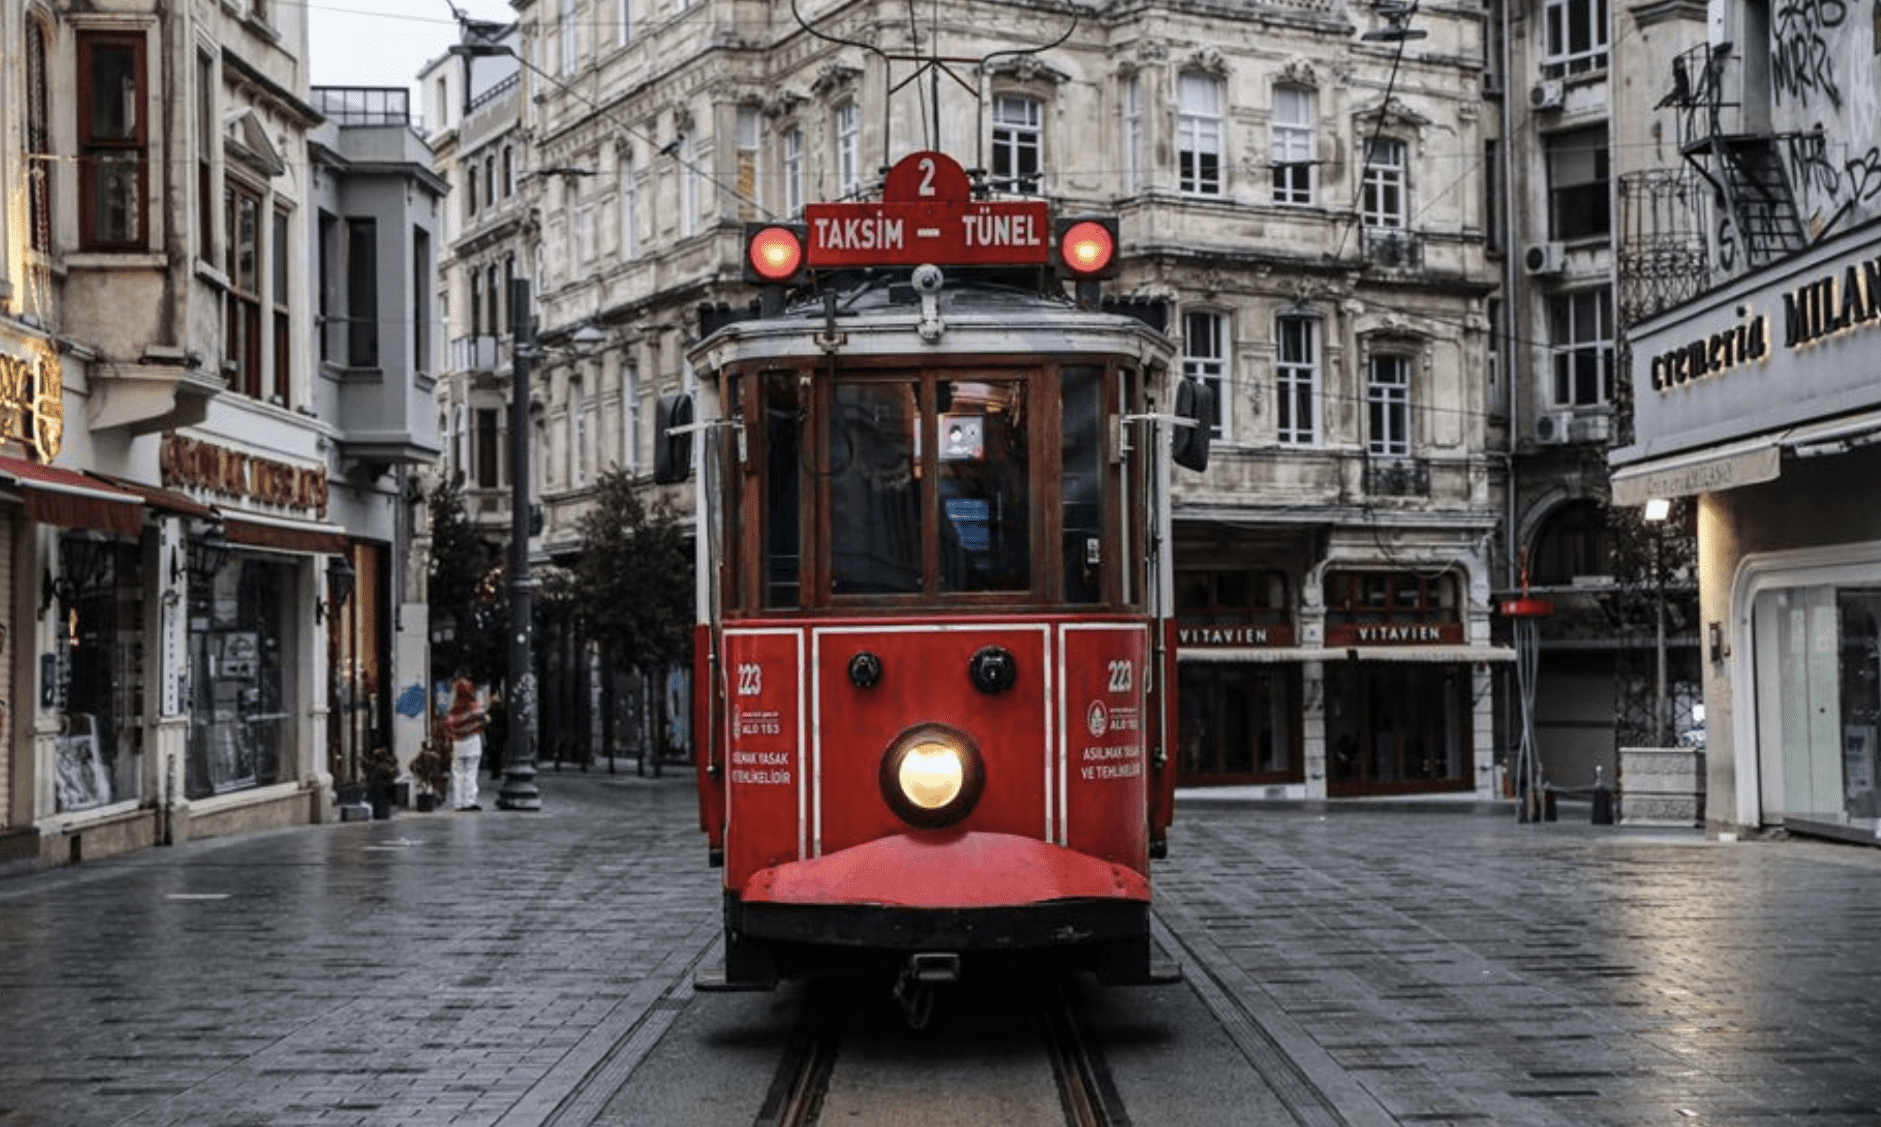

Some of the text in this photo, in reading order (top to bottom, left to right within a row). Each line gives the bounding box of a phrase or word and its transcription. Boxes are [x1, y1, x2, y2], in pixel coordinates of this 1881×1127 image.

[917, 157, 936, 197] 2
[815, 209, 904, 250] TAKSİM
[962, 207, 1040, 247] TÜNEL
[1652, 306, 1764, 391] cremeria
[1179, 628, 1267, 643] VITAVIEN
[1359, 627, 1441, 641] VITAVIEN
[738, 663, 762, 695] 223
[1108, 659, 1132, 692] 223
